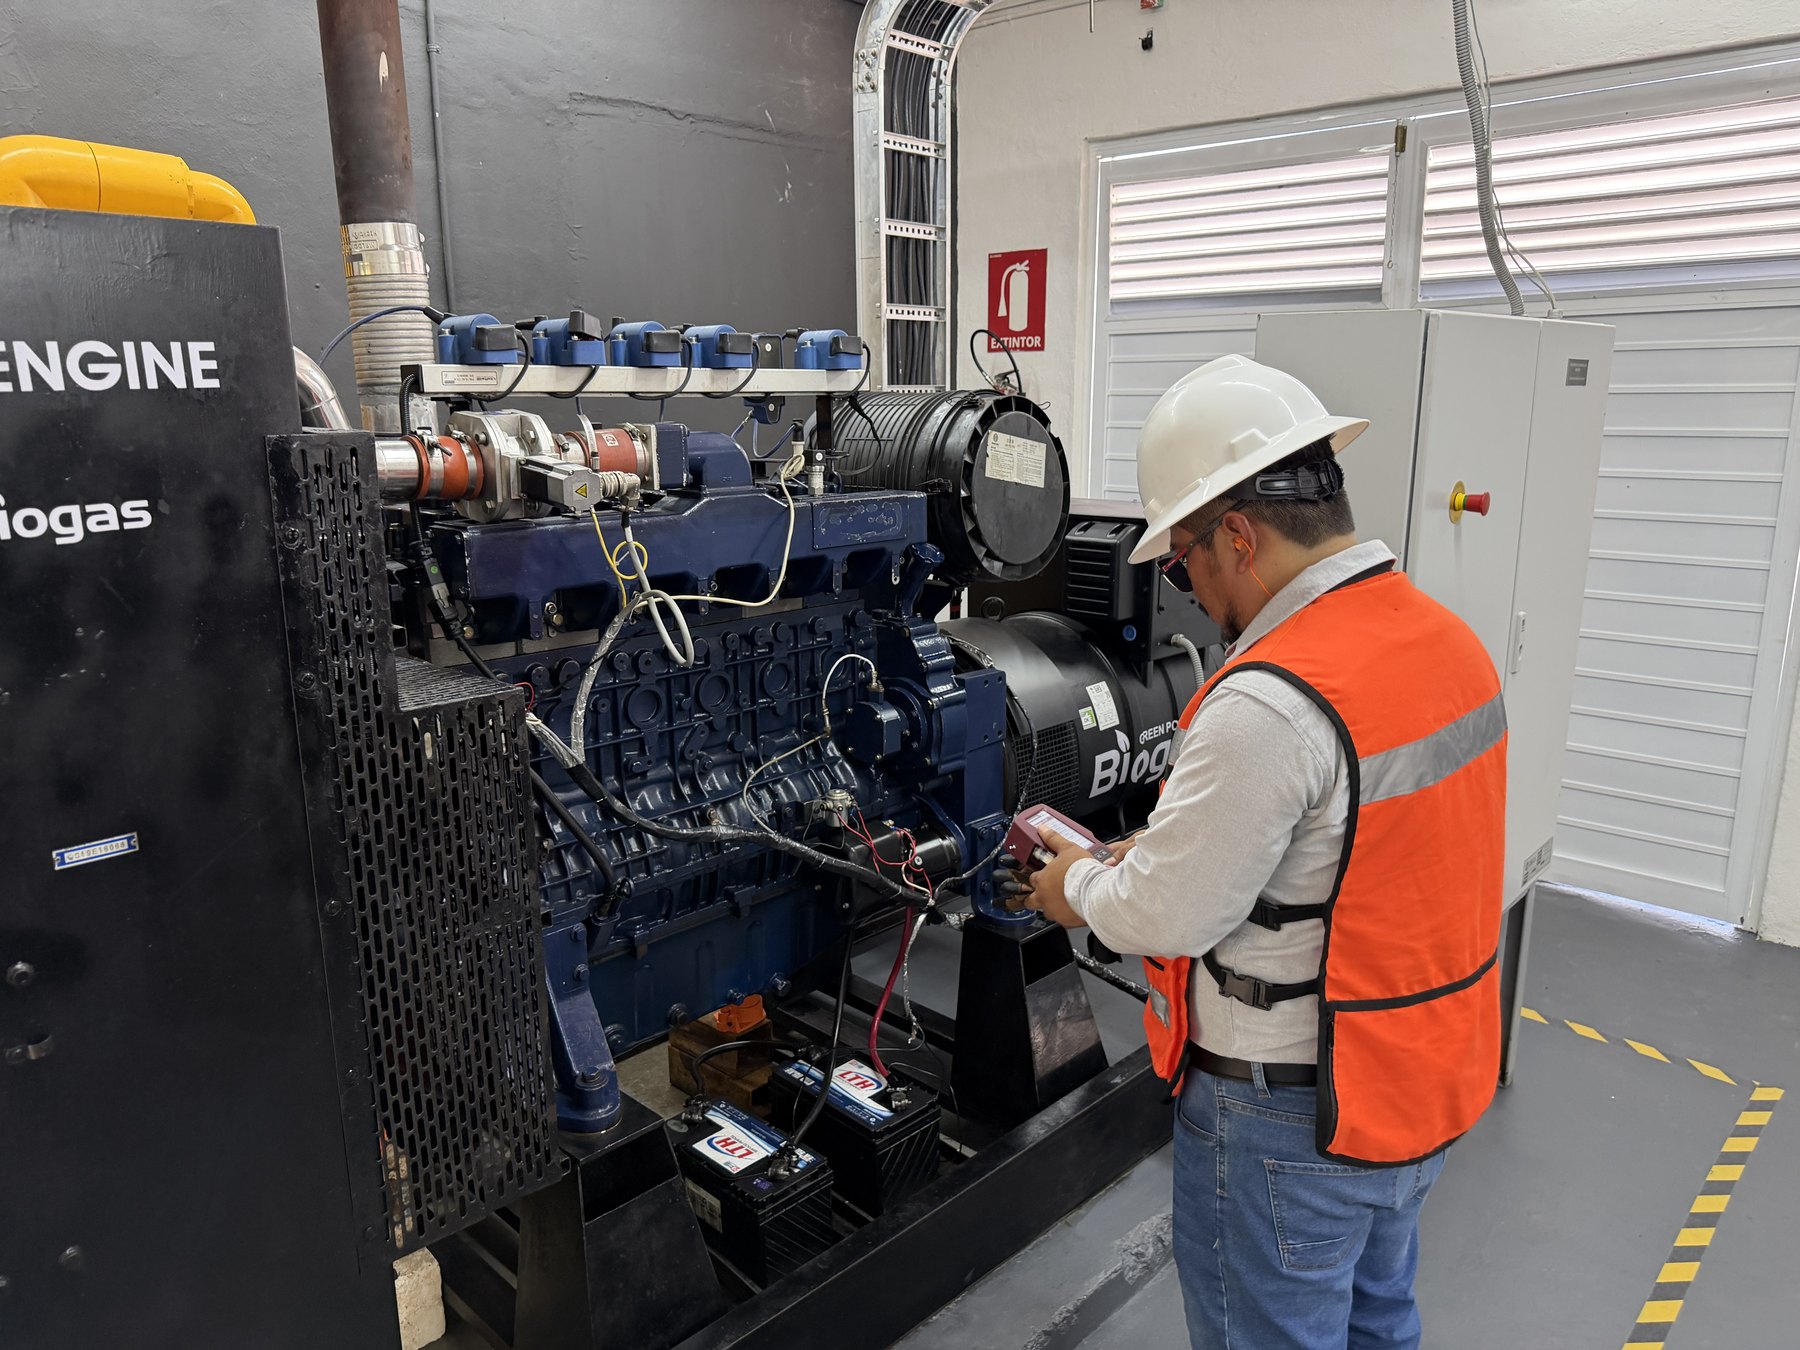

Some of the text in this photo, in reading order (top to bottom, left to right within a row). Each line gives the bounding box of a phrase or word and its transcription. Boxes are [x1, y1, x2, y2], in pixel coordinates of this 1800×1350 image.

[1140, 723, 1165, 745] GREEN
[837, 1070, 876, 1090] LTH
[714, 1136, 754, 1159] LTH
